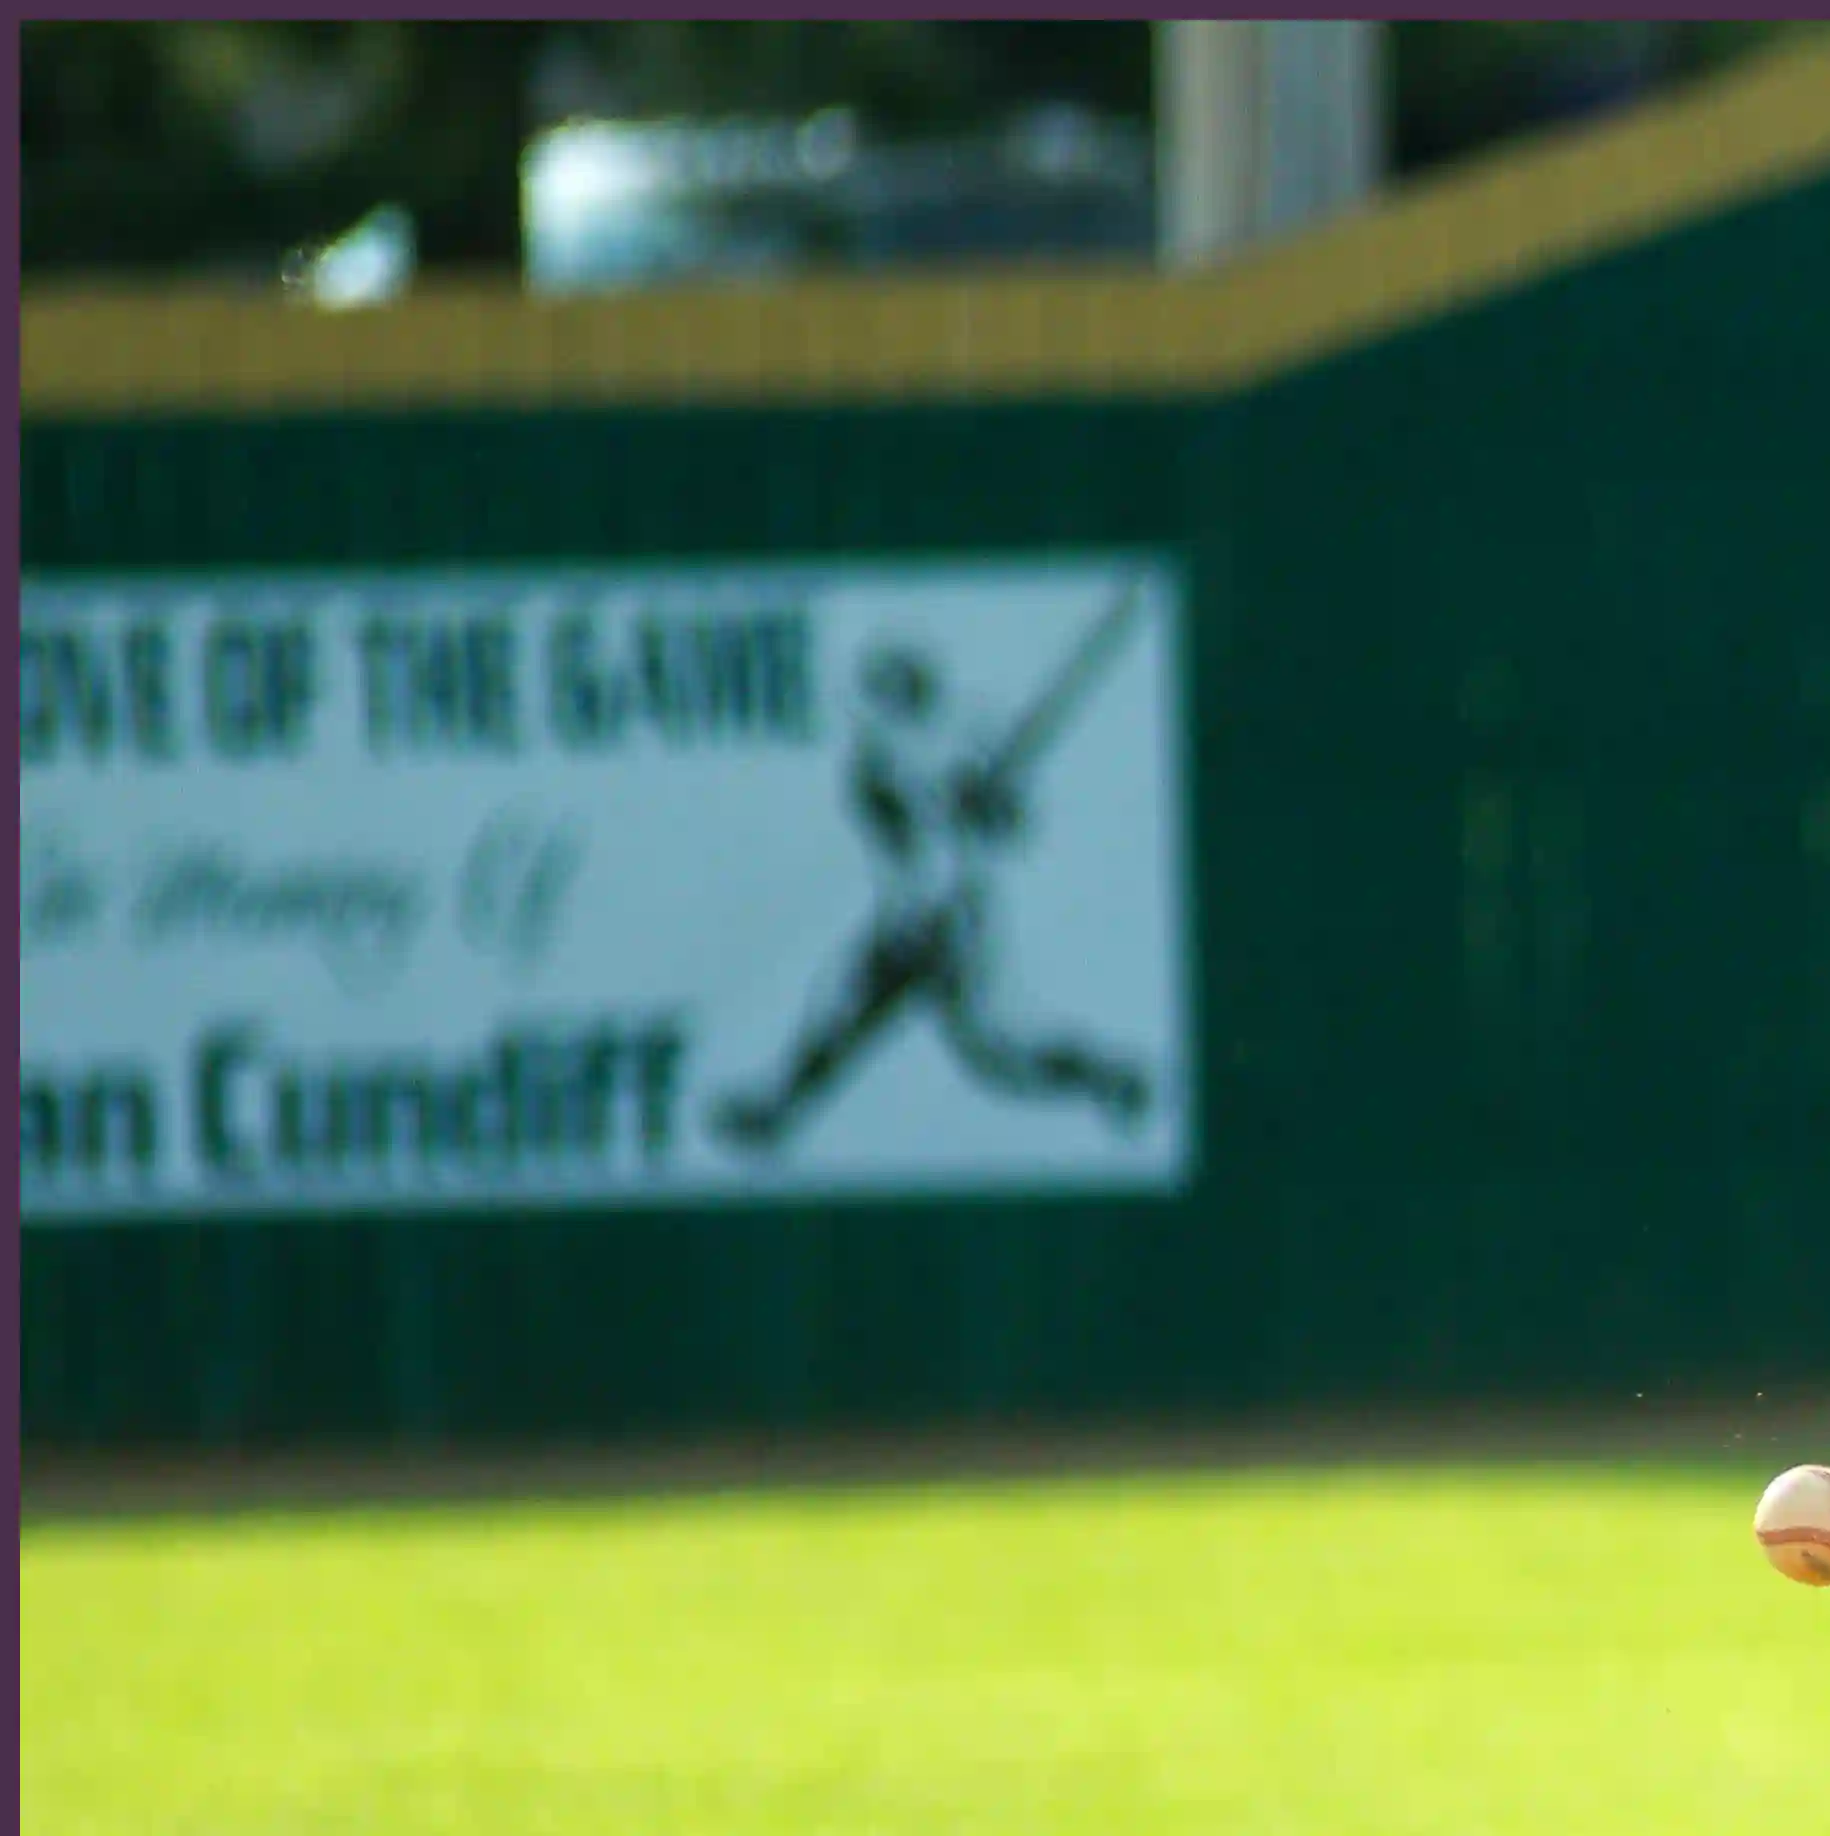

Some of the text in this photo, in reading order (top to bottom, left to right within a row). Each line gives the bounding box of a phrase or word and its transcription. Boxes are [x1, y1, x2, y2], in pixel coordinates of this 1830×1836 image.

[204, 610, 316, 762] OF
[358, 606, 520, 756] THE
[547, 602, 818, 748] GAME
[192, 1008, 692, 1170] Cundiff
